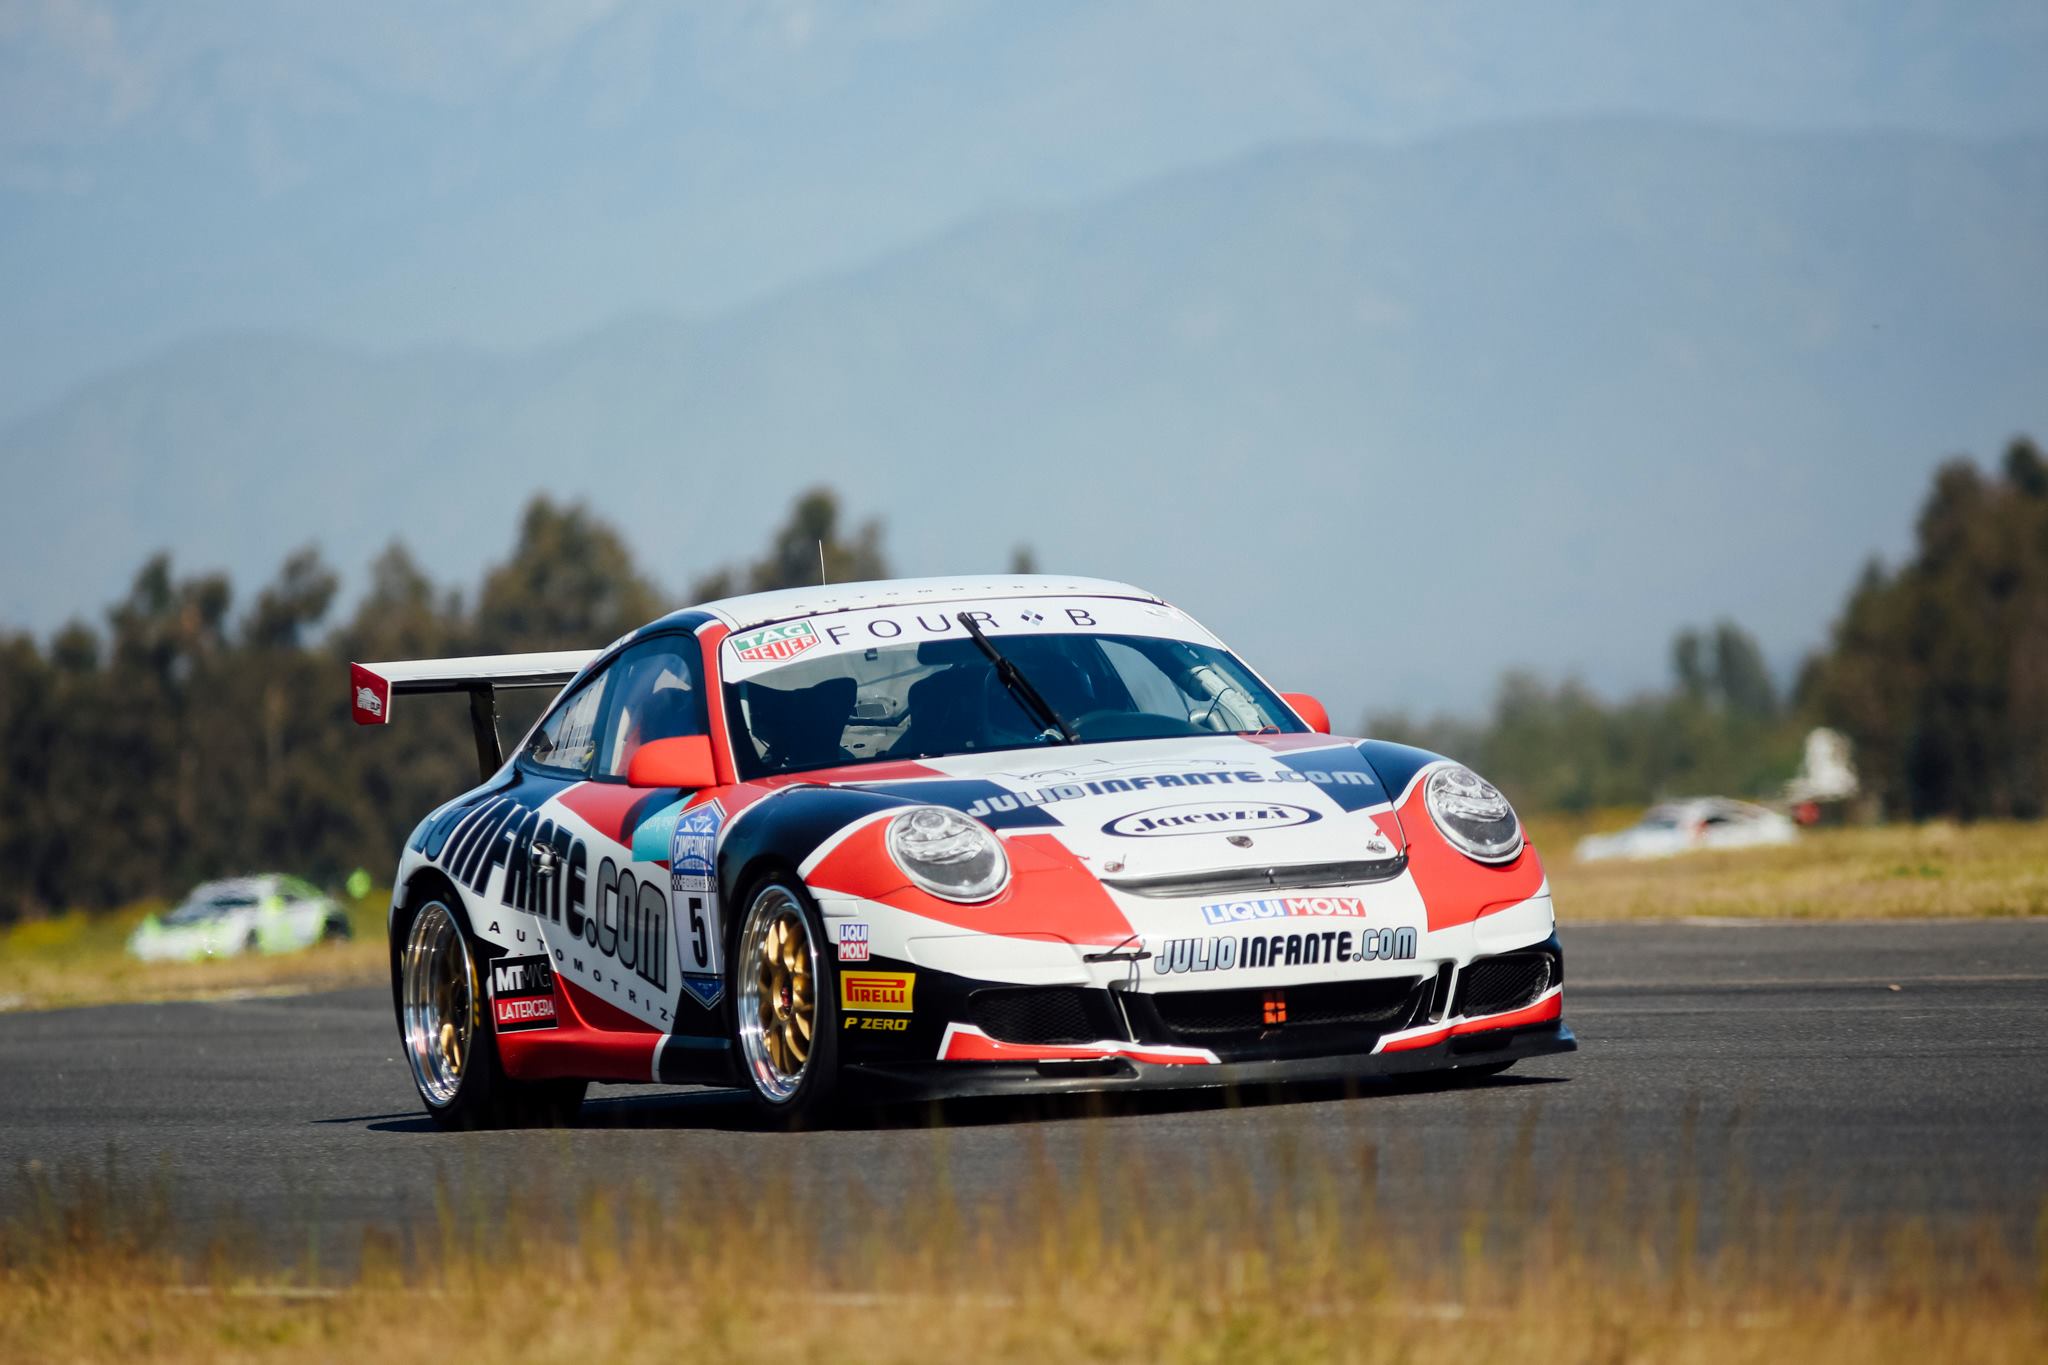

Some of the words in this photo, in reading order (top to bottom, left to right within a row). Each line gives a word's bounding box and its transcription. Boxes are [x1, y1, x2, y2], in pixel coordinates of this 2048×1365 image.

[738, 624, 808, 649] TAG
[826, 611, 1000, 645] FOUR
[1065, 609, 1097, 626] B
[742, 635, 815, 661] HEUER
[1133, 806, 1291, 832] Jacuzzi
[1206, 899, 1285, 925] LIQUI
[1287, 898, 1362, 918] MOLY
[688, 897, 708, 968] 5
[841, 925, 868, 941] LIQUI
[841, 942, 868, 959] MOLY
[488, 920, 668, 1022] AUTOMOTRIZ
[845, 977, 906, 1004] PIRELLI
[844, 1017, 858, 1029] P
[860, 1017, 909, 1031] ZERO
